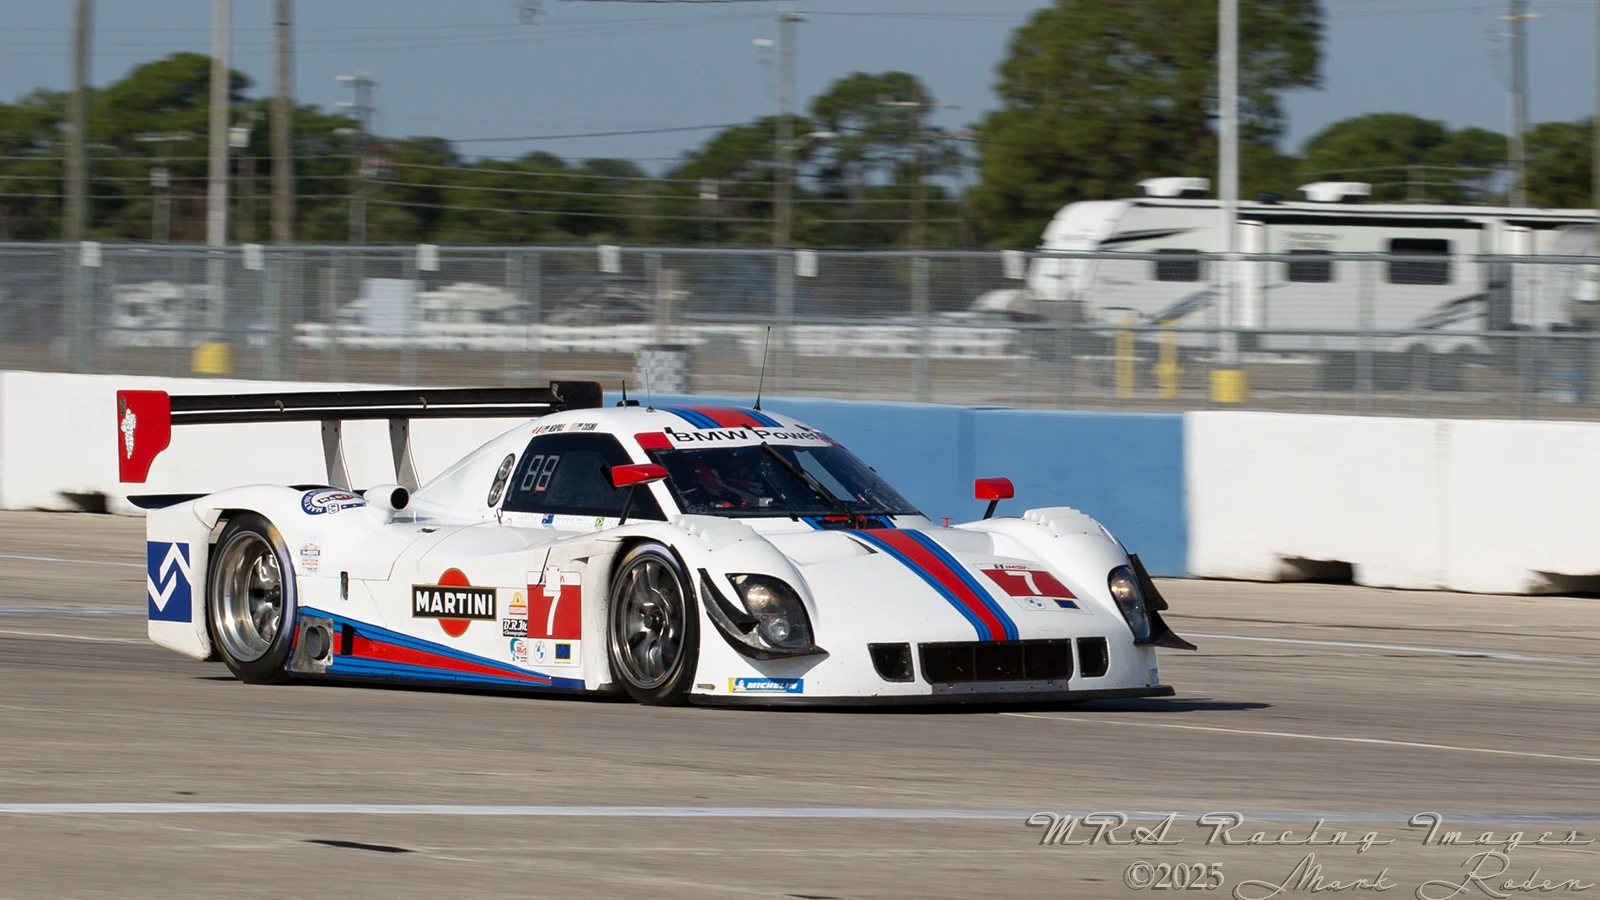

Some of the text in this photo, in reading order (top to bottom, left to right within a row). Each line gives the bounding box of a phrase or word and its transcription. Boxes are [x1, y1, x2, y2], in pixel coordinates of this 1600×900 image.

[674, 429, 818, 442] BMW Power
[1004, 570, 1043, 595] 7
[416, 591, 493, 616] MARTINI
[542, 586, 562, 636] 7
[746, 682, 798, 690] MICHELIN
